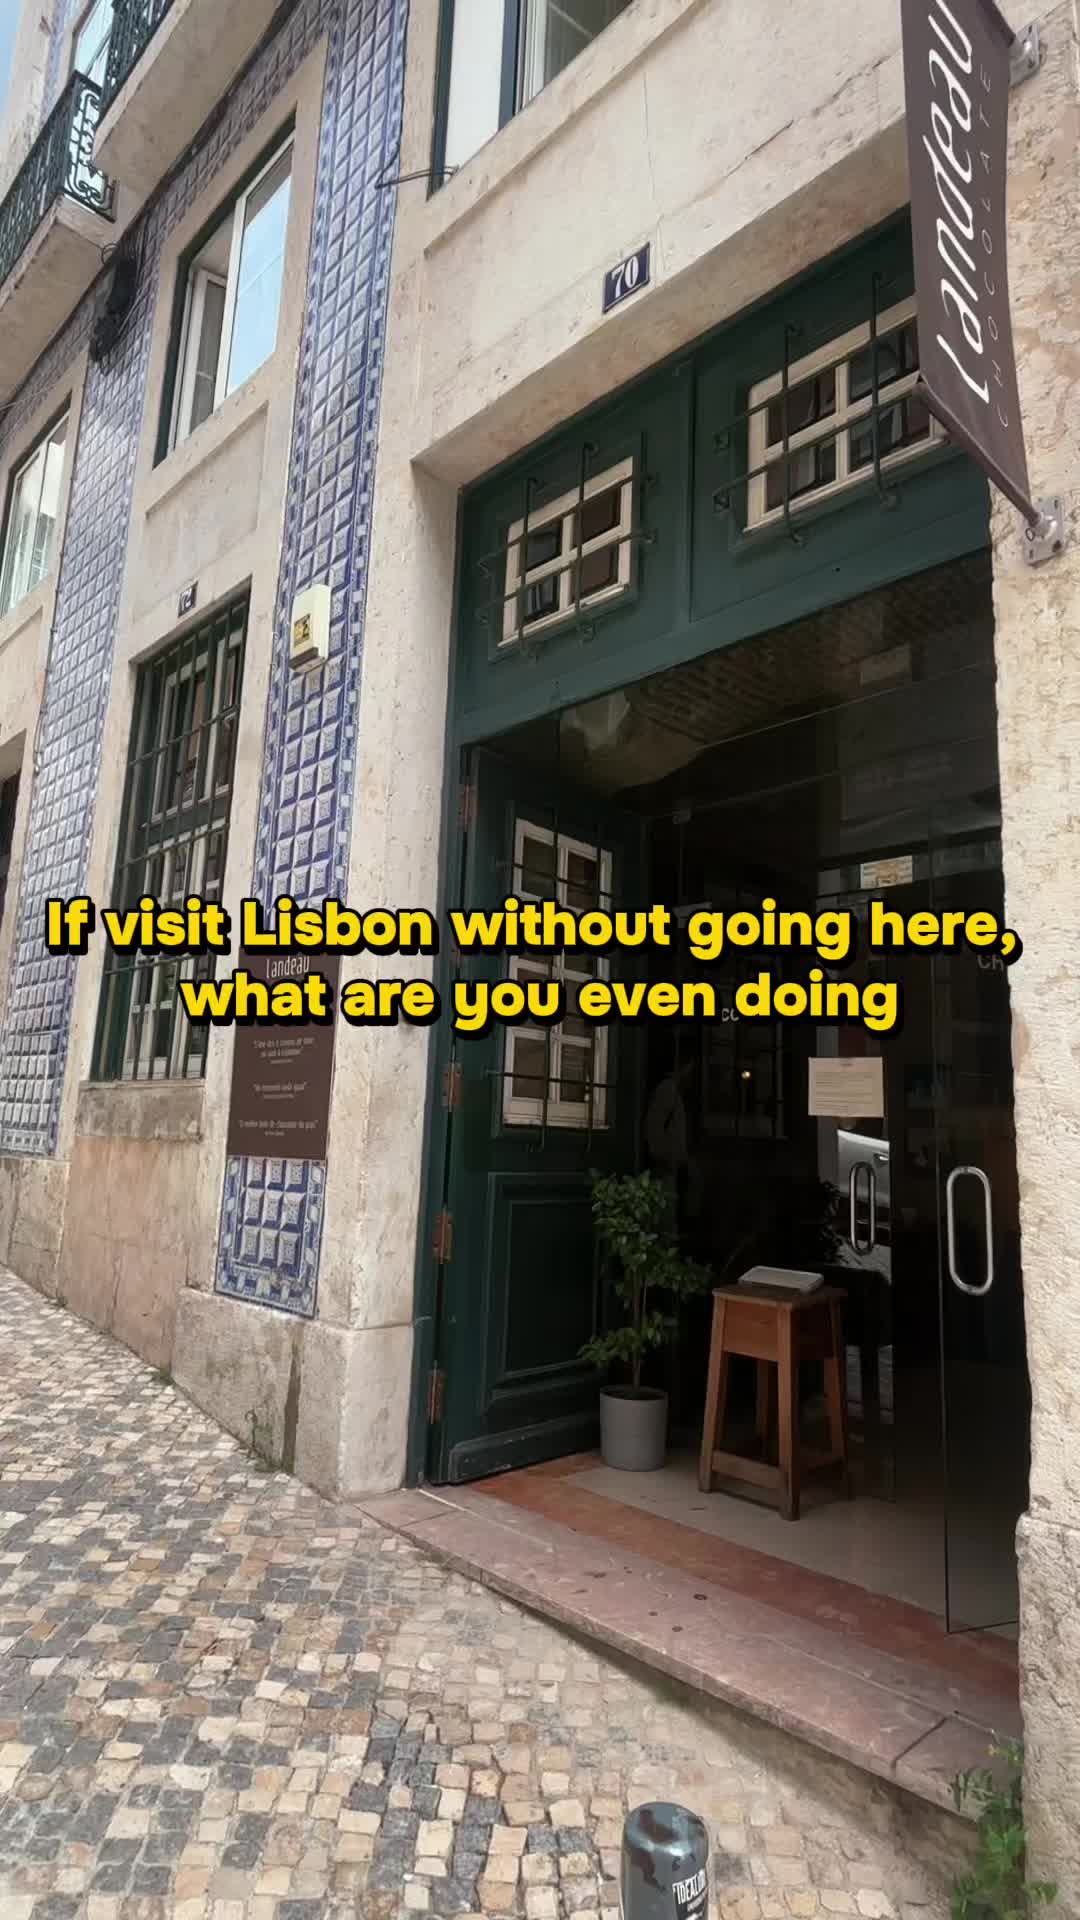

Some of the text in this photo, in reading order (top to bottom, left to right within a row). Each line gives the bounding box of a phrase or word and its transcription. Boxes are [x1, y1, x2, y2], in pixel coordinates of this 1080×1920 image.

[611, 255, 639, 299] 70
[922, 0, 989, 404] Landeau
[979, 63, 1009, 428] CHOCOLATE
[265, 955, 311, 979] Landeau
